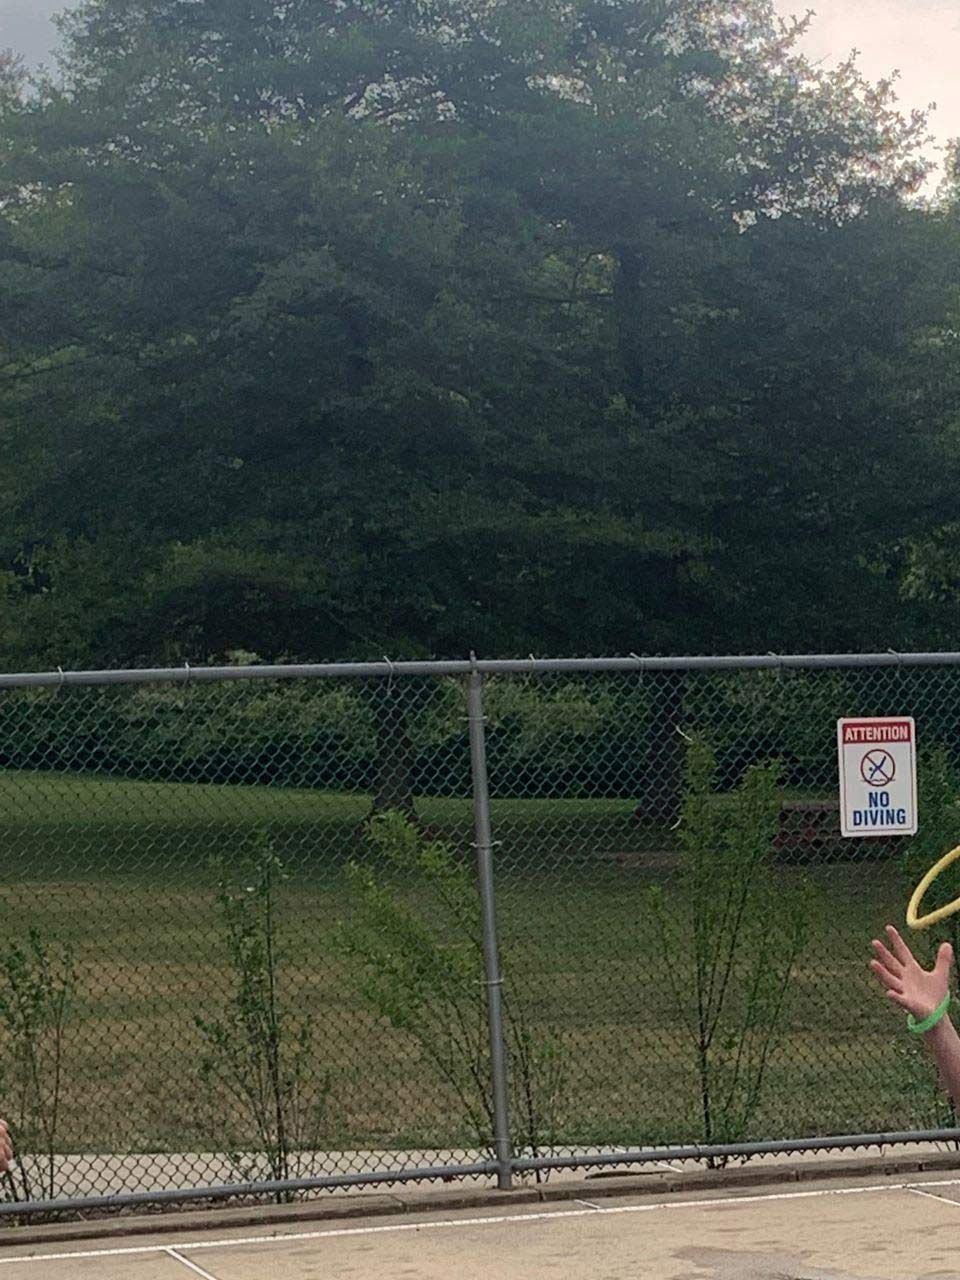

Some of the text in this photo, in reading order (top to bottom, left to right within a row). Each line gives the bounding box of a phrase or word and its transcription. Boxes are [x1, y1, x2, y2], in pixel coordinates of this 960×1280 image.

[845, 725, 908, 741] ATTENTION
[868, 791, 890, 808] NO
[853, 808, 906, 827] DIVING
